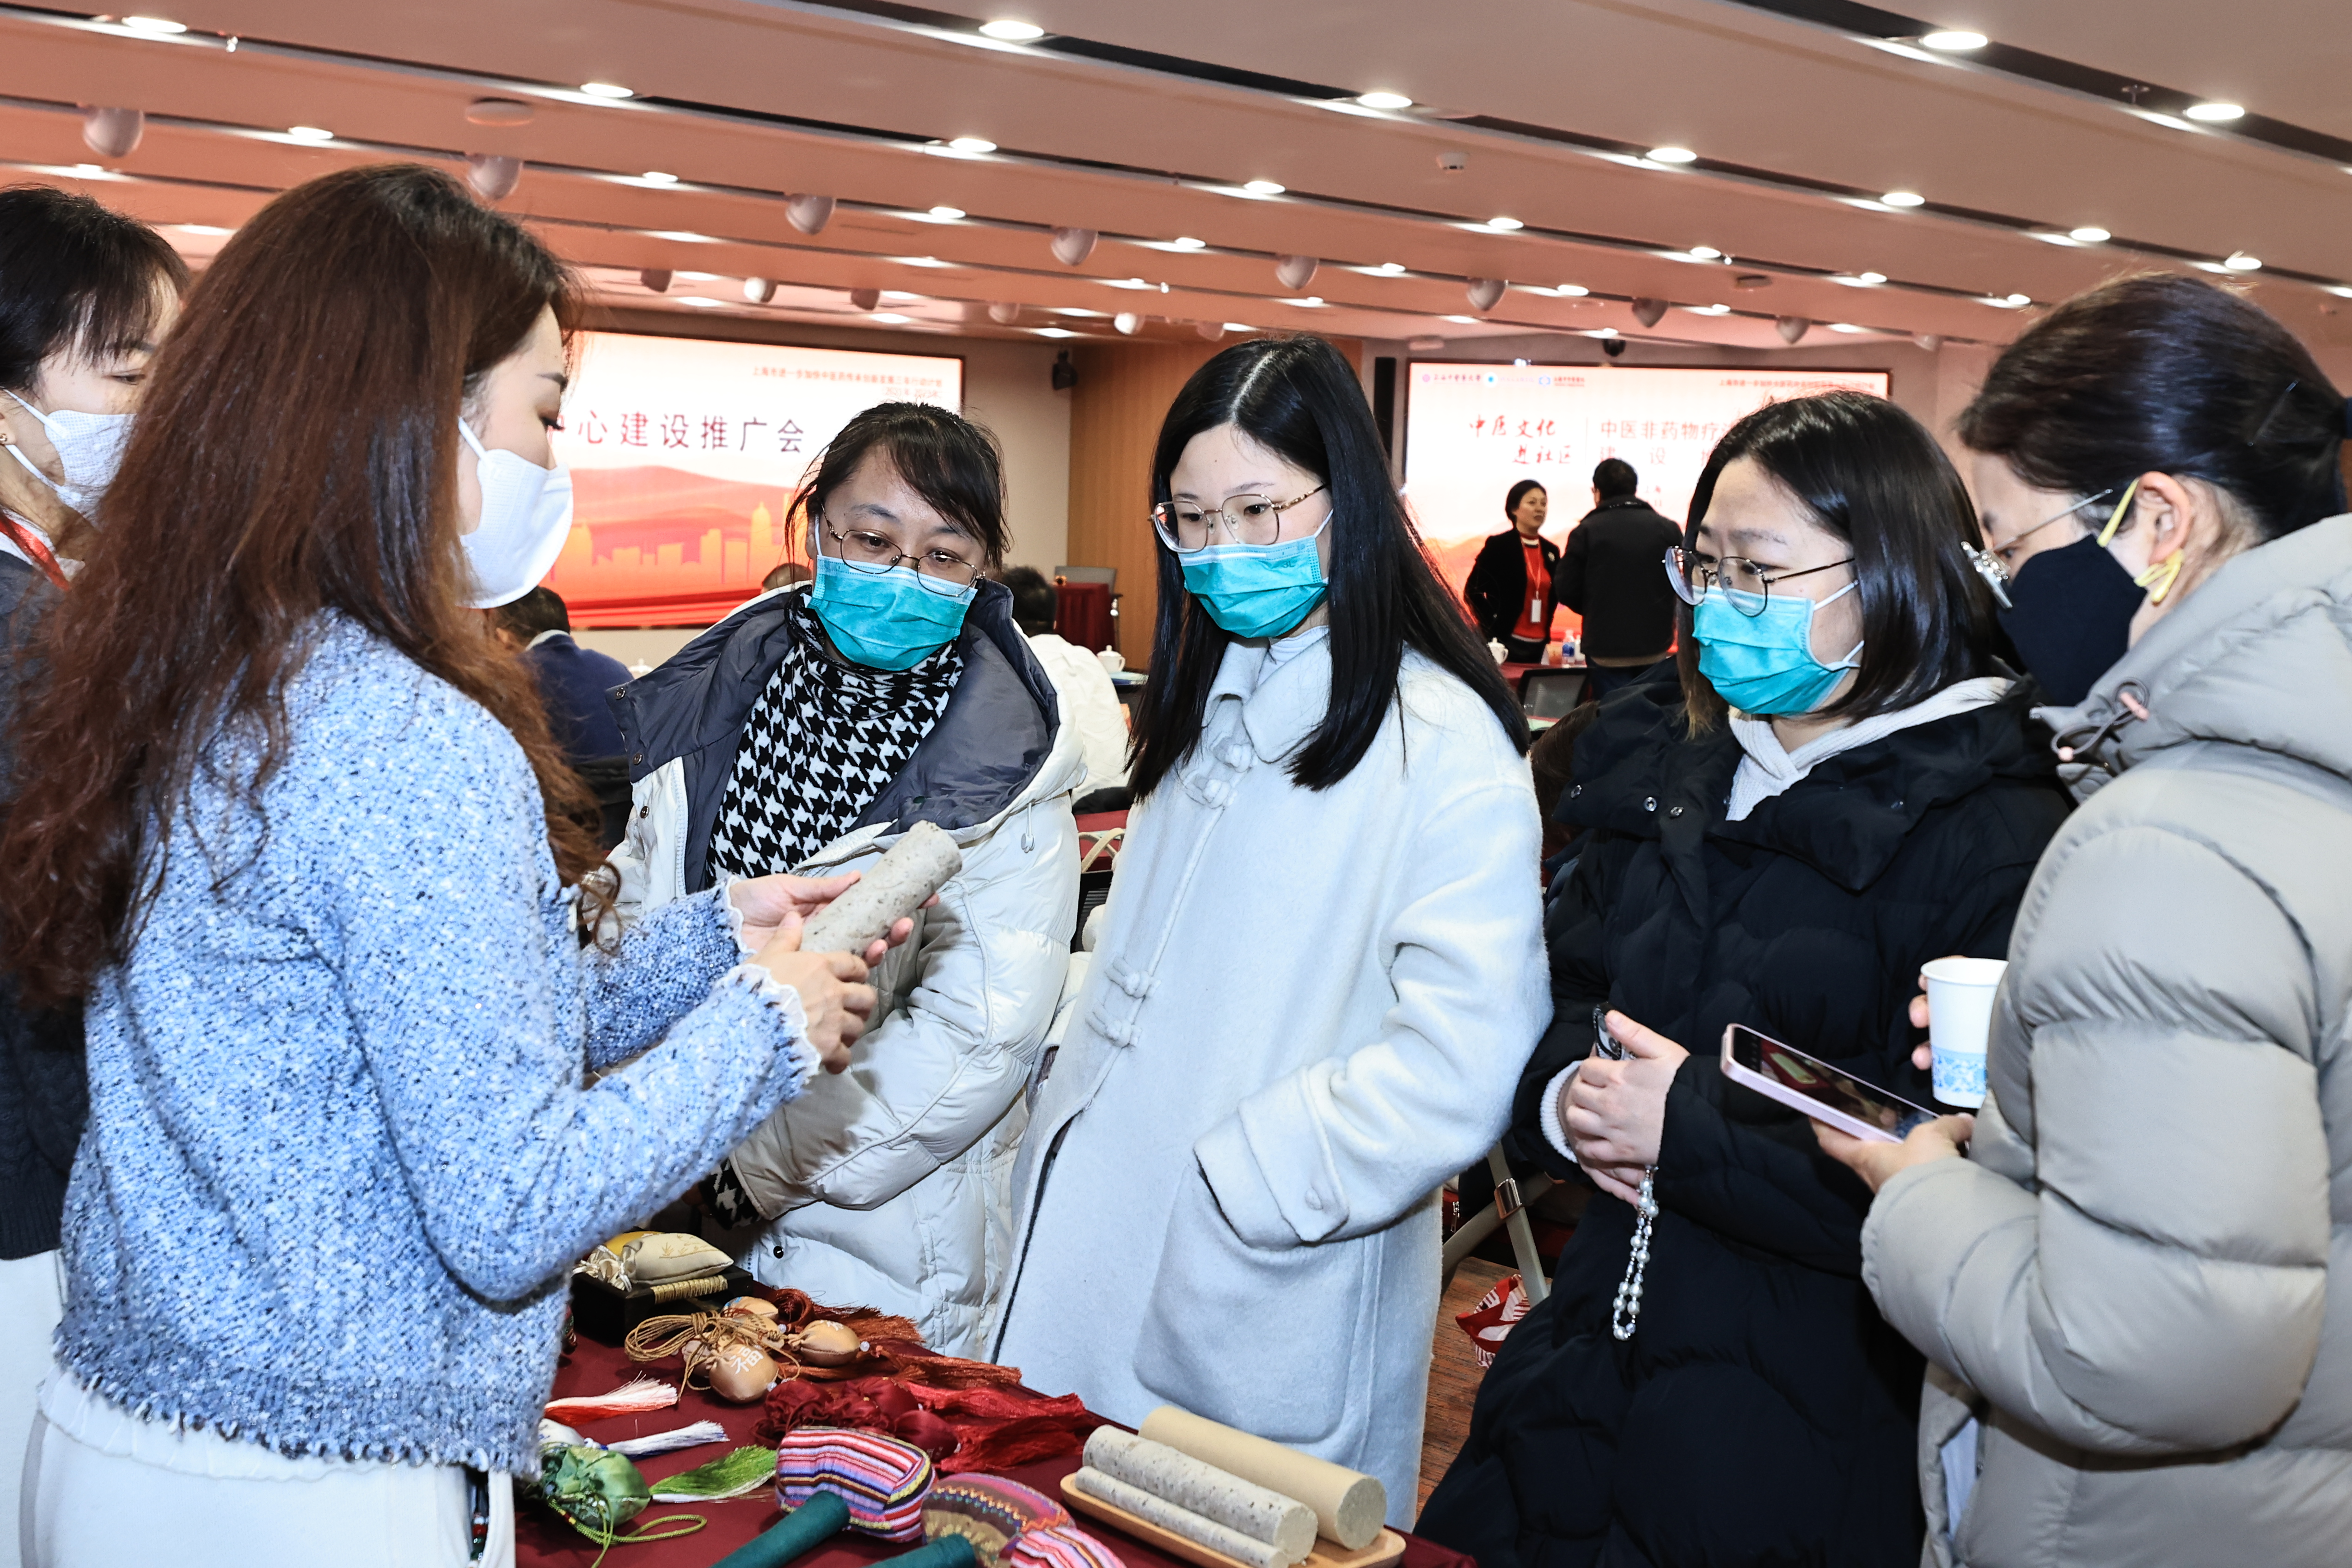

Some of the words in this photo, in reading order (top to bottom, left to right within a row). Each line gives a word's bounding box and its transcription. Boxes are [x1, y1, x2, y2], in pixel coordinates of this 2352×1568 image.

[1601, 419, 1728, 441] 中医非药物疗
[730, 1346, 765, 1374] 福
